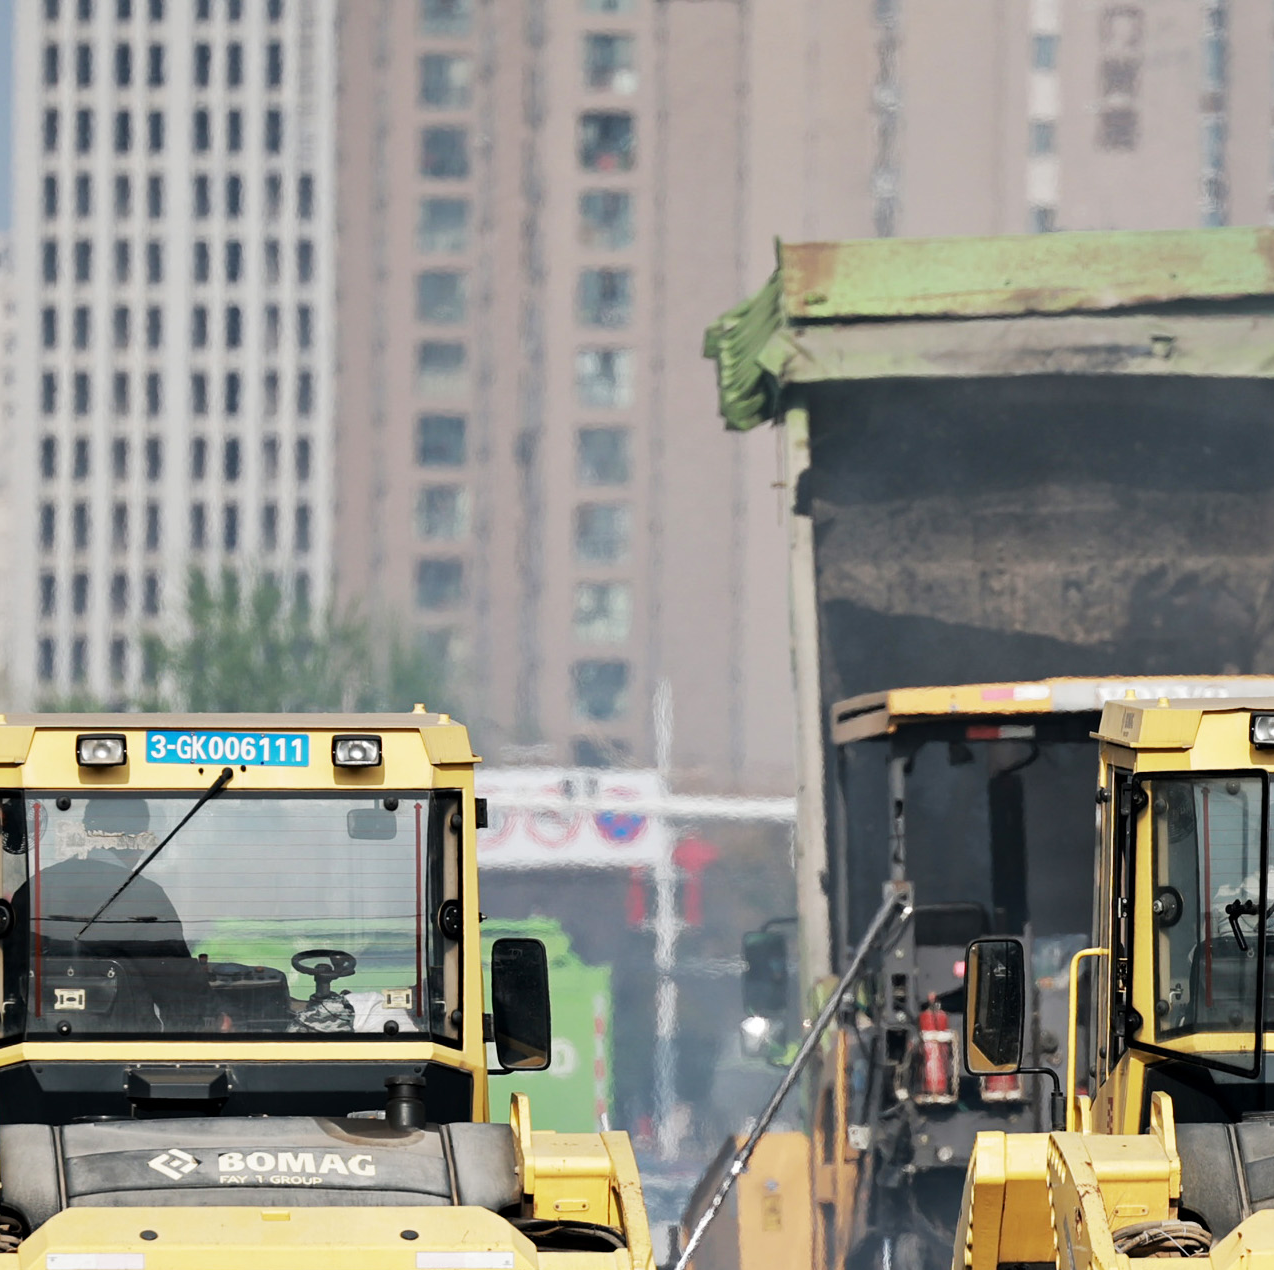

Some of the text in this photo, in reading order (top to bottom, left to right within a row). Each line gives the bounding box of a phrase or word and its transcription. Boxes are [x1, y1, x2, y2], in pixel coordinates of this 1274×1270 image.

[150, 734, 303, 762] 3-GK006111
[218, 1151, 375, 1176] BOMAG
[219, 1175, 265, 1184] FAYT
